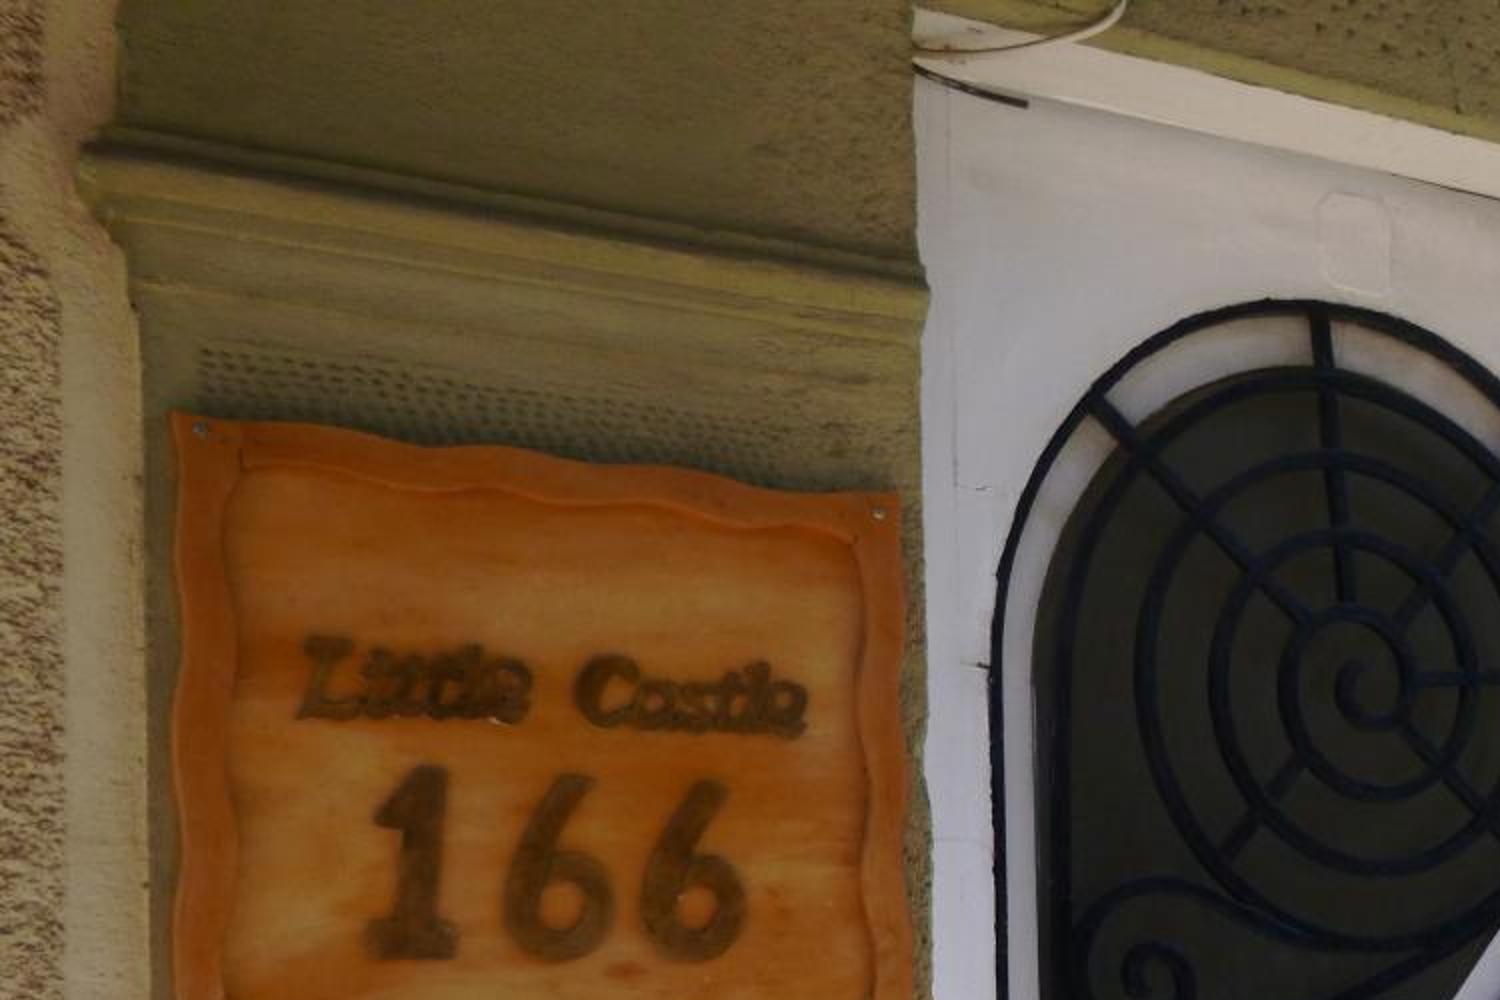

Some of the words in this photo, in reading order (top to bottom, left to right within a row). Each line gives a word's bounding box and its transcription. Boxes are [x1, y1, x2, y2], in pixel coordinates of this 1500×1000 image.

[296, 632, 536, 724] Little
[576, 653, 809, 741] Castle
[365, 763, 747, 965] 166
